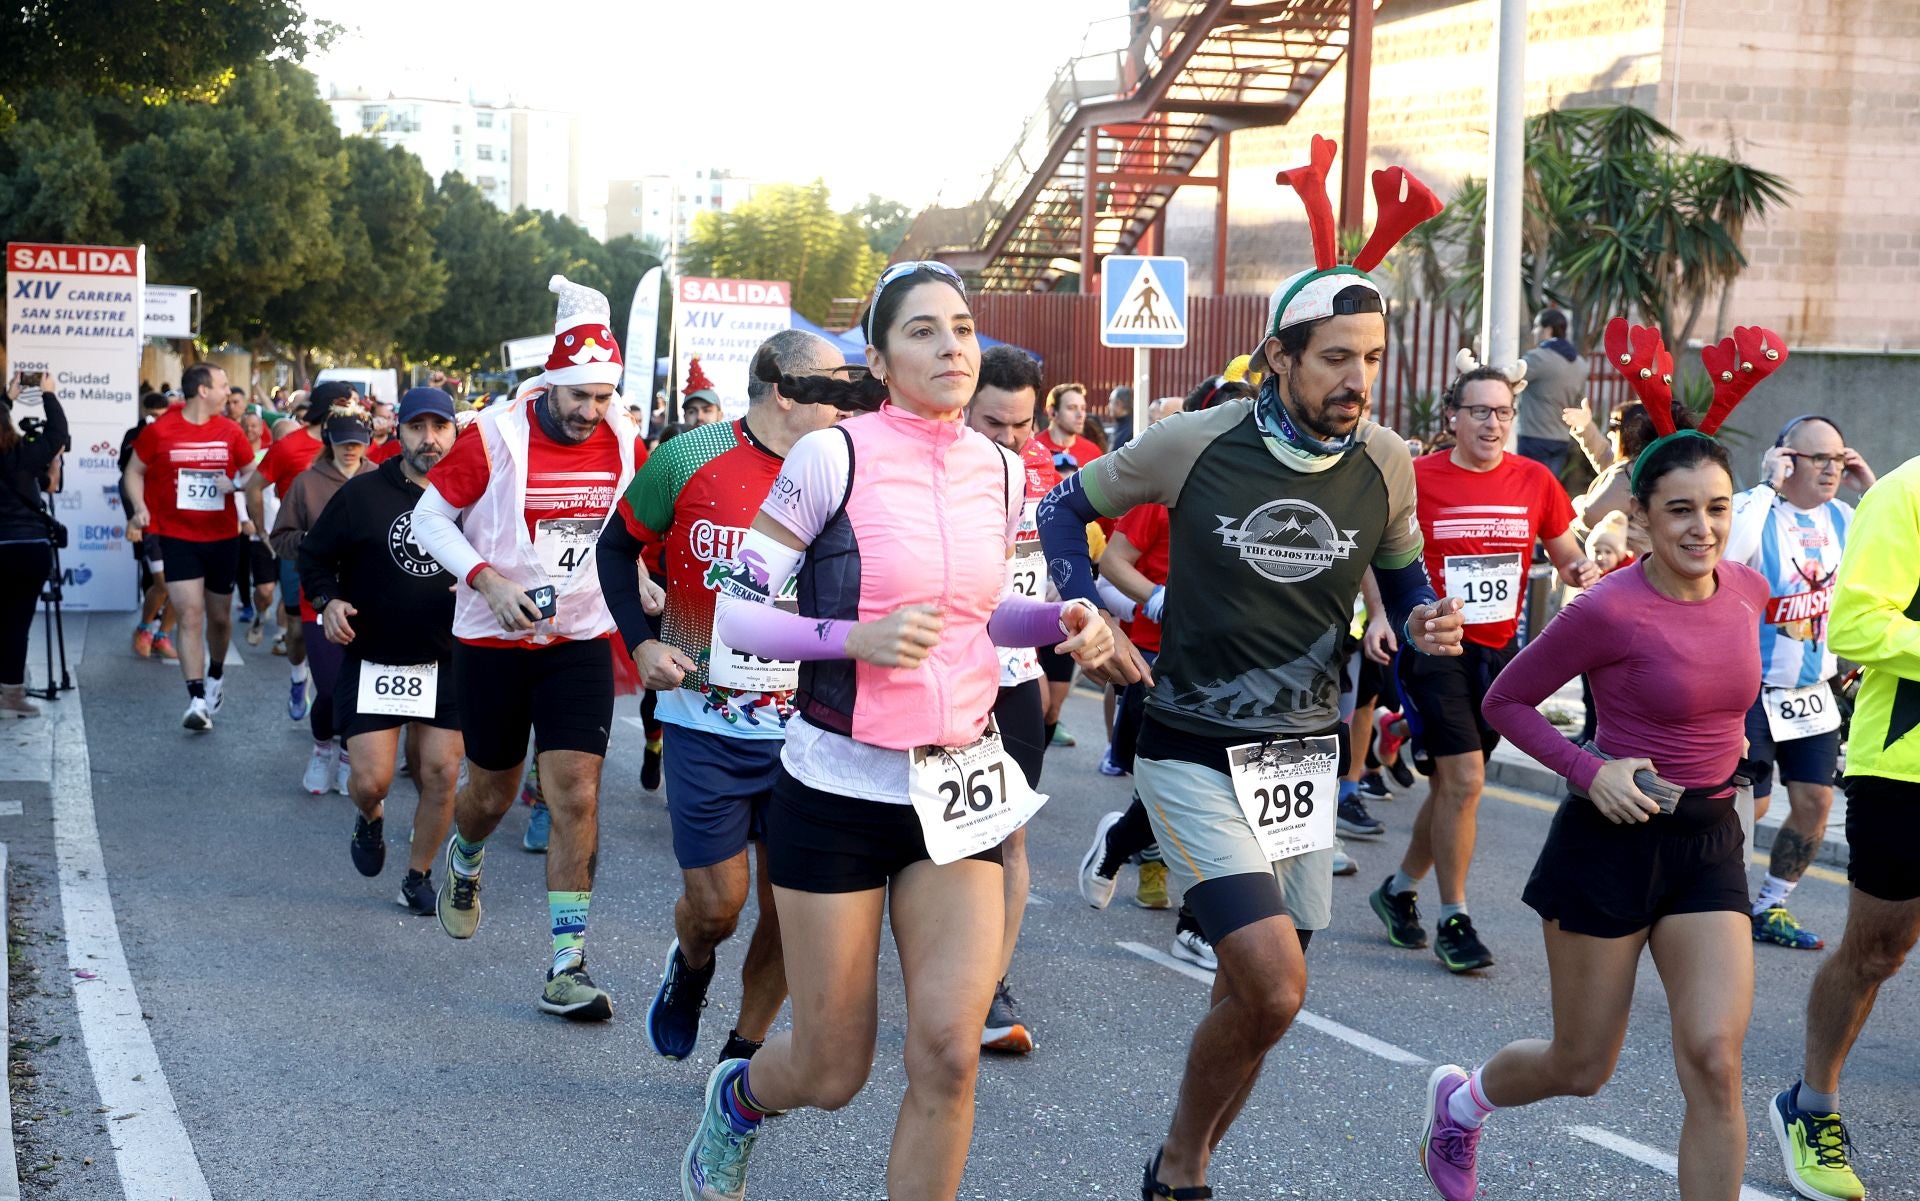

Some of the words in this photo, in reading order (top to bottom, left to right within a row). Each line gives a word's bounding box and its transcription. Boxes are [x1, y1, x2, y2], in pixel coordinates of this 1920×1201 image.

[14, 248, 132, 273] SALIDA
[13, 279, 61, 300] XIV
[68, 290, 132, 302] CARRERA
[683, 280, 785, 305] SALIDA
[21, 307, 53, 320] SAN
[56, 309, 127, 322] SILVESTRE
[684, 310, 724, 329] XIV
[729, 319, 786, 332] CARRERA
[11, 324, 61, 336] PALMA
[65, 325, 134, 338] PALMILLA
[691, 336, 716, 347] SAN
[683, 352, 725, 362] PLMA
[58, 371, 110, 384] Ciudad
[58, 387, 76, 399] de
[81, 387, 132, 403] Málaga
[188, 484, 217, 499] 570
[553, 500, 583, 510] PALMA
[392, 513, 413, 549] TRAZ
[1460, 530, 1490, 539] PALMA
[1491, 530, 1529, 539] PALMILLA
[1245, 546, 1267, 556] THE
[1268, 548, 1303, 560] COJOS
[1304, 552, 1333, 562] TEAM
[404, 560, 440, 574] CLUB
[1463, 579, 1508, 603] 198
[375, 675, 422, 697] 688
[1780, 694, 1823, 720] 820
[1294, 760, 1332, 769] CARRERA
[1301, 753, 1336, 763] XIV
[1288, 768, 1331, 777] PALMILLA
[1291, 764, 1331, 773] SILVESTRE
[938, 761, 1007, 822] 267
[1254, 780, 1314, 828] 298
